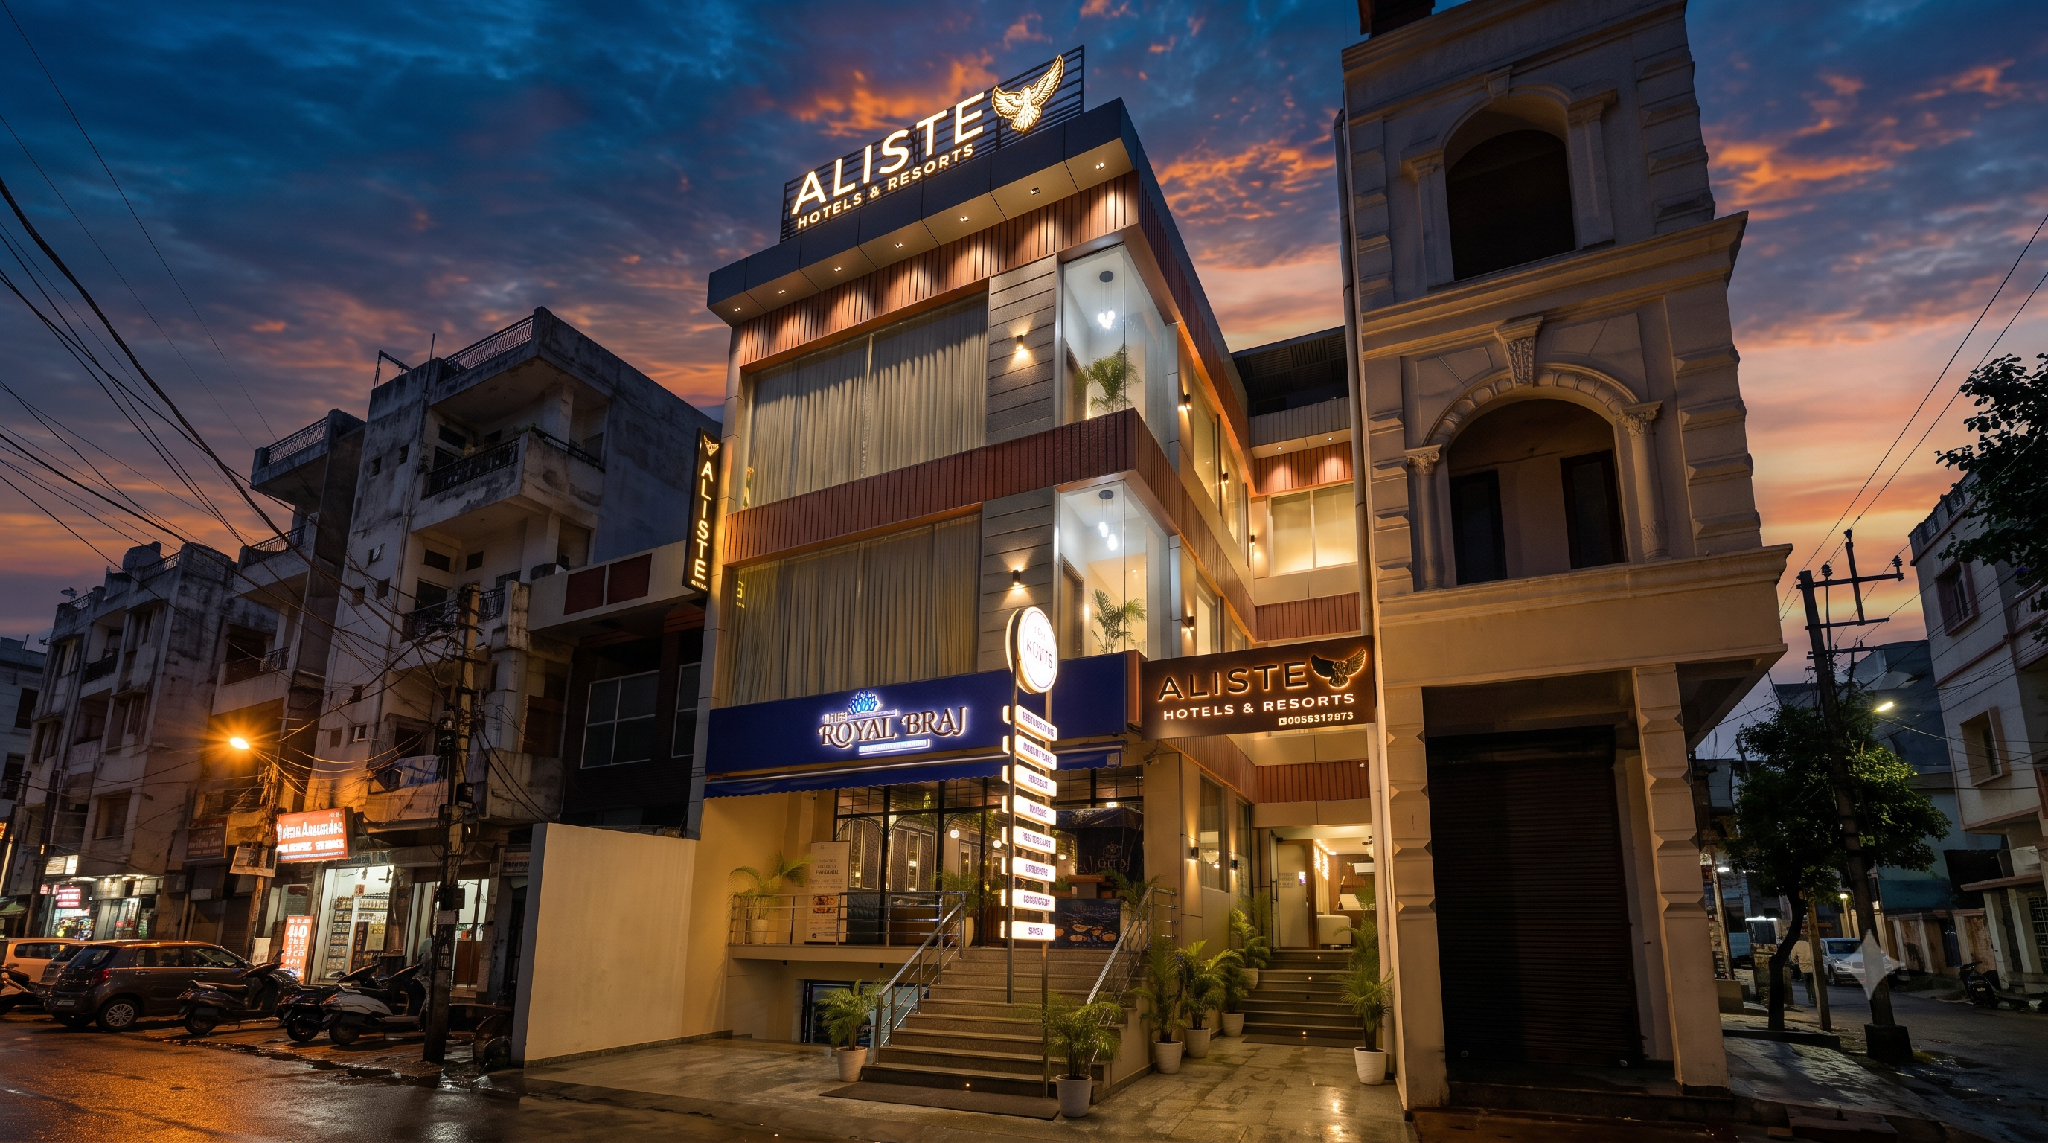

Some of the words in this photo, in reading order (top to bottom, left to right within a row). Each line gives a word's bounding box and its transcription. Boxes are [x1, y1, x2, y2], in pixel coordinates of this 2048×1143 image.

[792, 91, 986, 216] ALISTE
[797, 193, 863, 229] HOTELS
[869, 185, 881, 200] &
[888, 144, 975, 191] RESORTS
[693, 460, 713, 580] ALISTE
[1158, 661, 1309, 702] ALISTE
[1163, 704, 1235, 721] HOTELS
[1242, 702, 1255, 715] &
[1263, 693, 1356, 712] RESORTS
[817, 718, 898, 749] ROYAL
[901, 706, 968, 737] BRAJ
